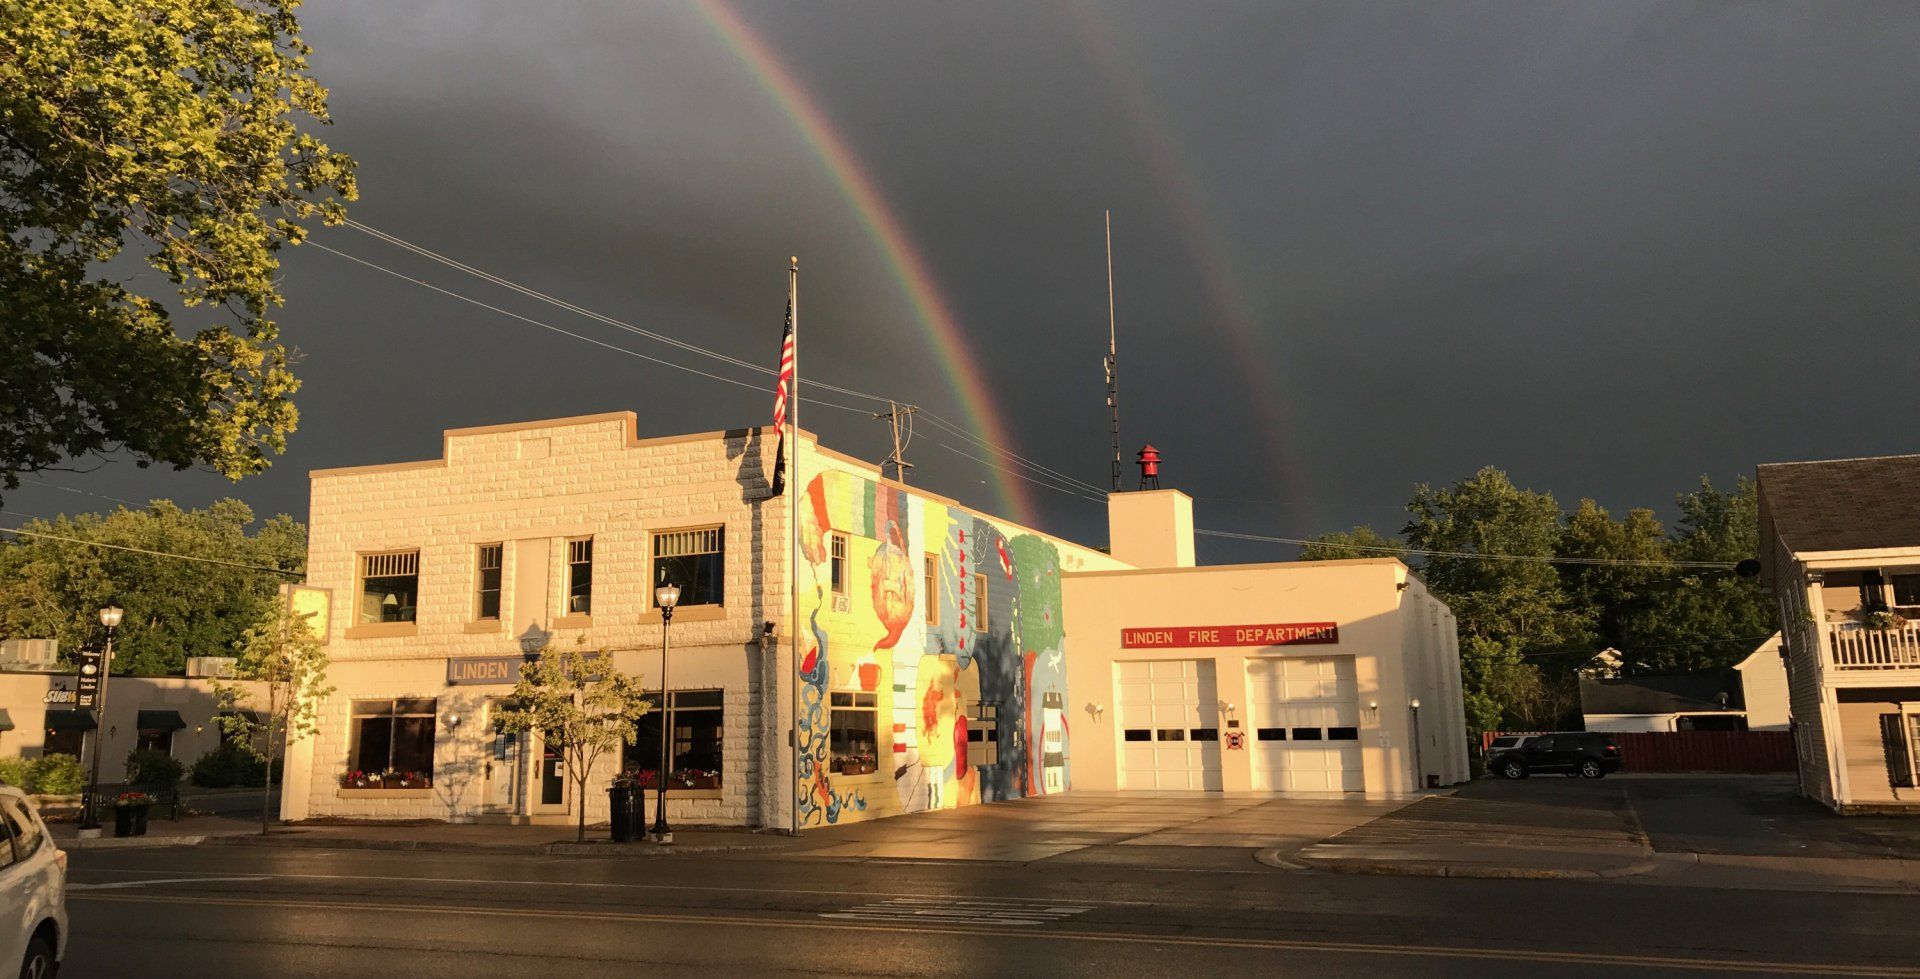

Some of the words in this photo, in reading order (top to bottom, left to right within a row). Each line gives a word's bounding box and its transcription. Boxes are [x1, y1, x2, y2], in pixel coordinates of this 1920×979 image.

[1125, 631, 1173, 645] LINDEN
[1188, 630, 1220, 643] FIRE
[1236, 626, 1335, 642] DEPARTMENT
[453, 662, 508, 680] LINDEN
[43, 690, 78, 703] SUBW
